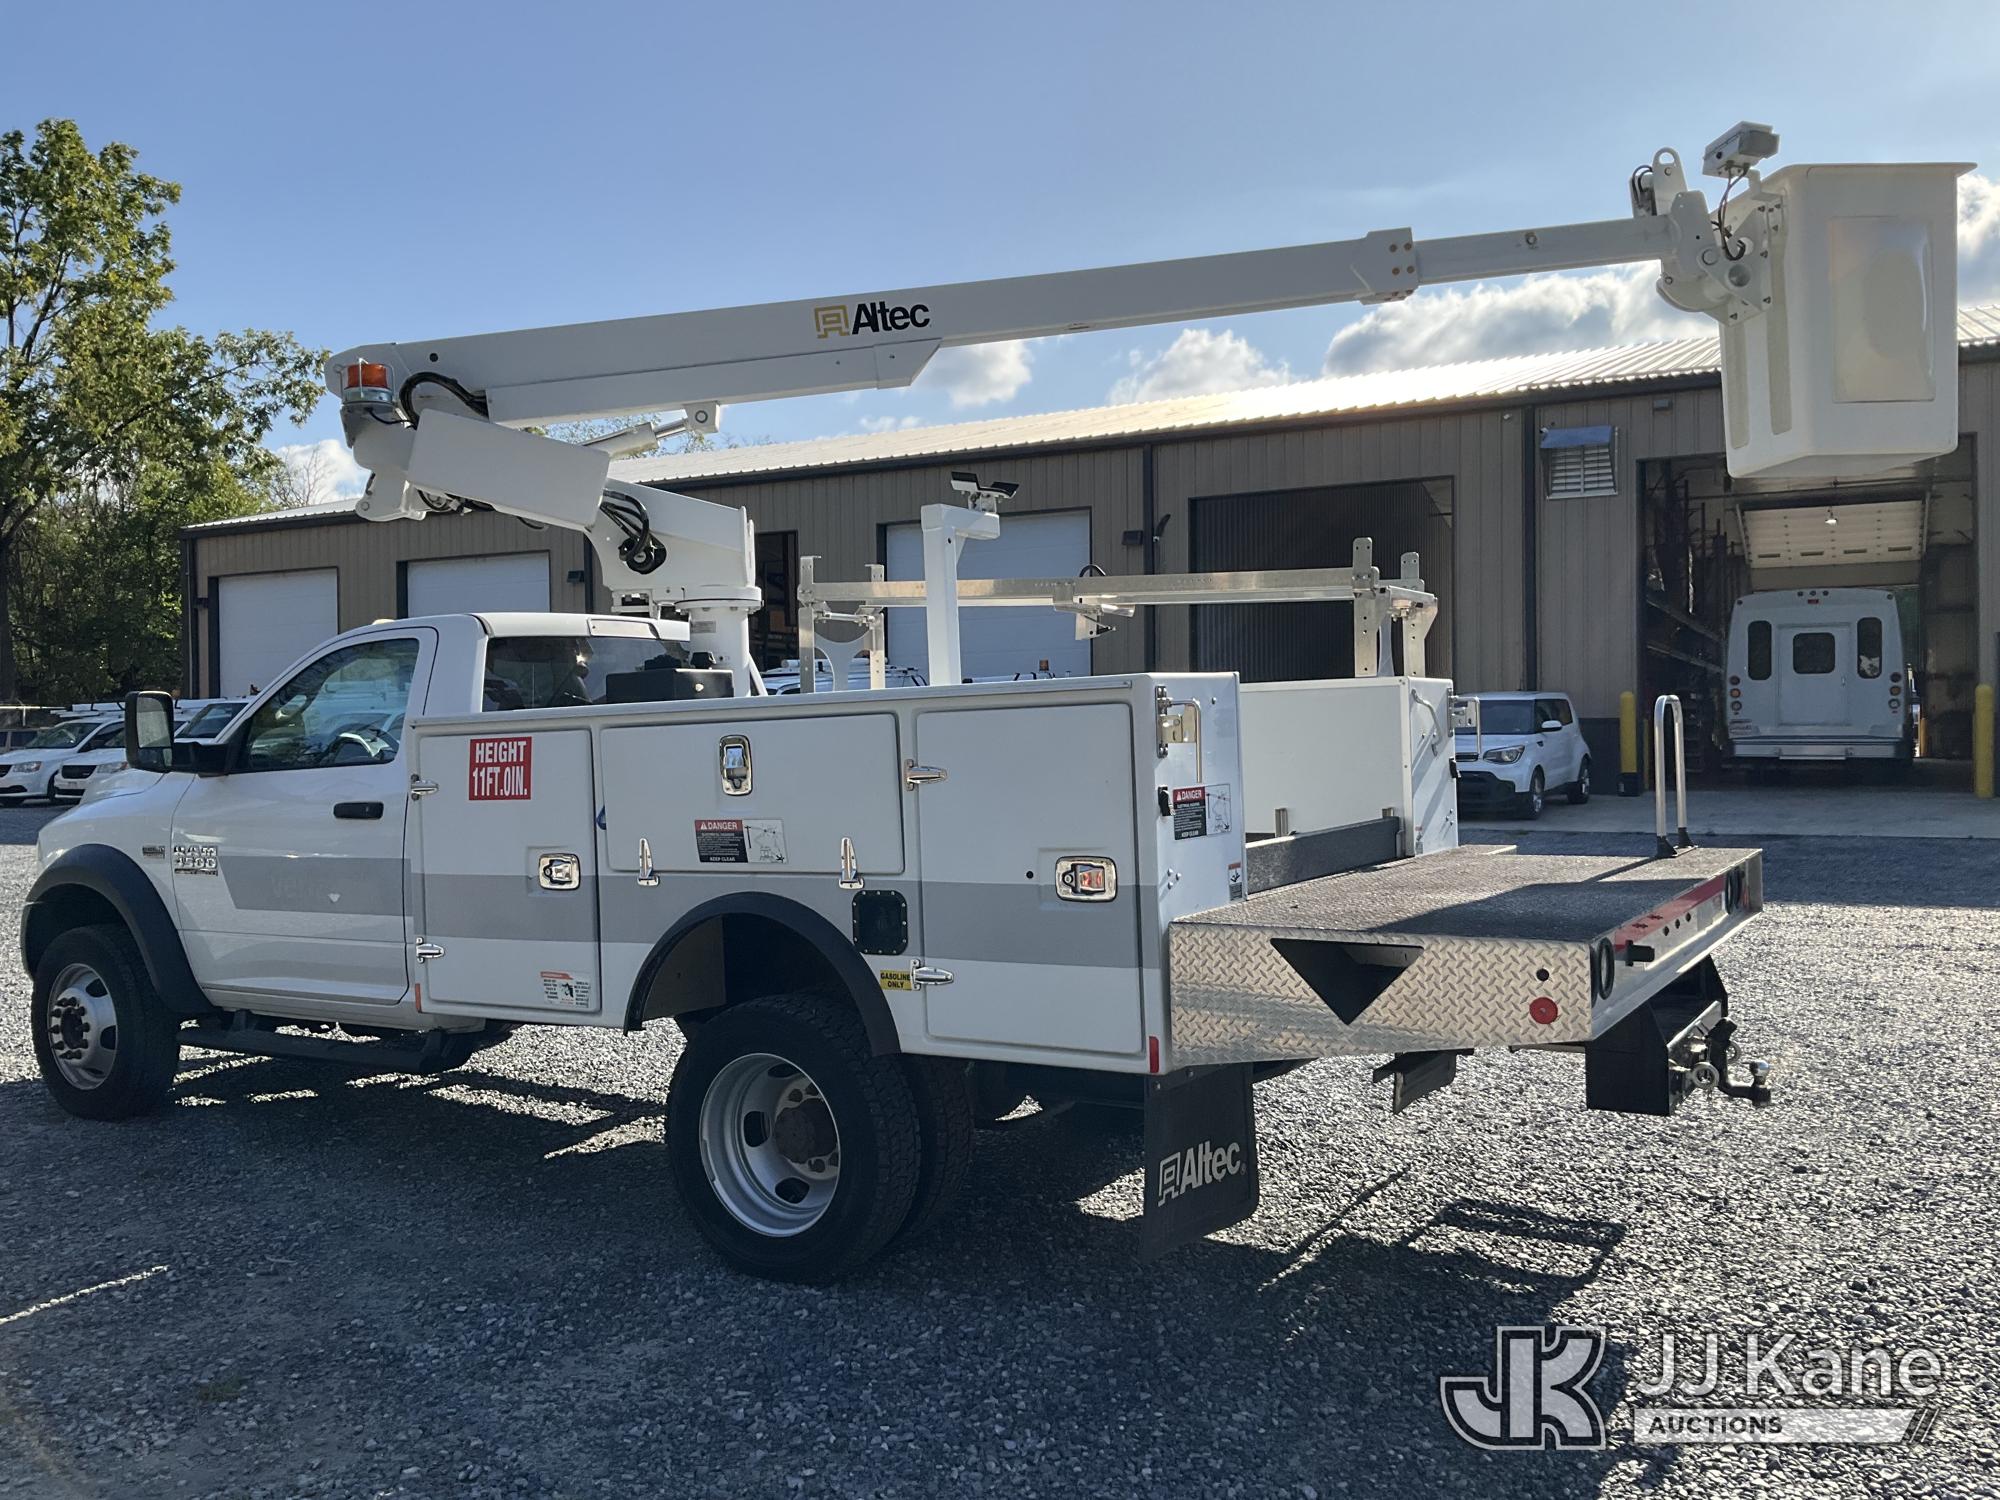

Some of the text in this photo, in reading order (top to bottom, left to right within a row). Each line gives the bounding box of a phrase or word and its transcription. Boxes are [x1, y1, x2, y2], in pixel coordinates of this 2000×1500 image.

[852, 301, 931, 335] Altec
[475, 741, 527, 763] HEIGHT
[1182, 789, 1202, 800] DANGER
[707, 821, 738, 830] DANGER
[880, 972, 911, 981] GASOLINE
[1180, 1140, 1241, 1195] Altec
